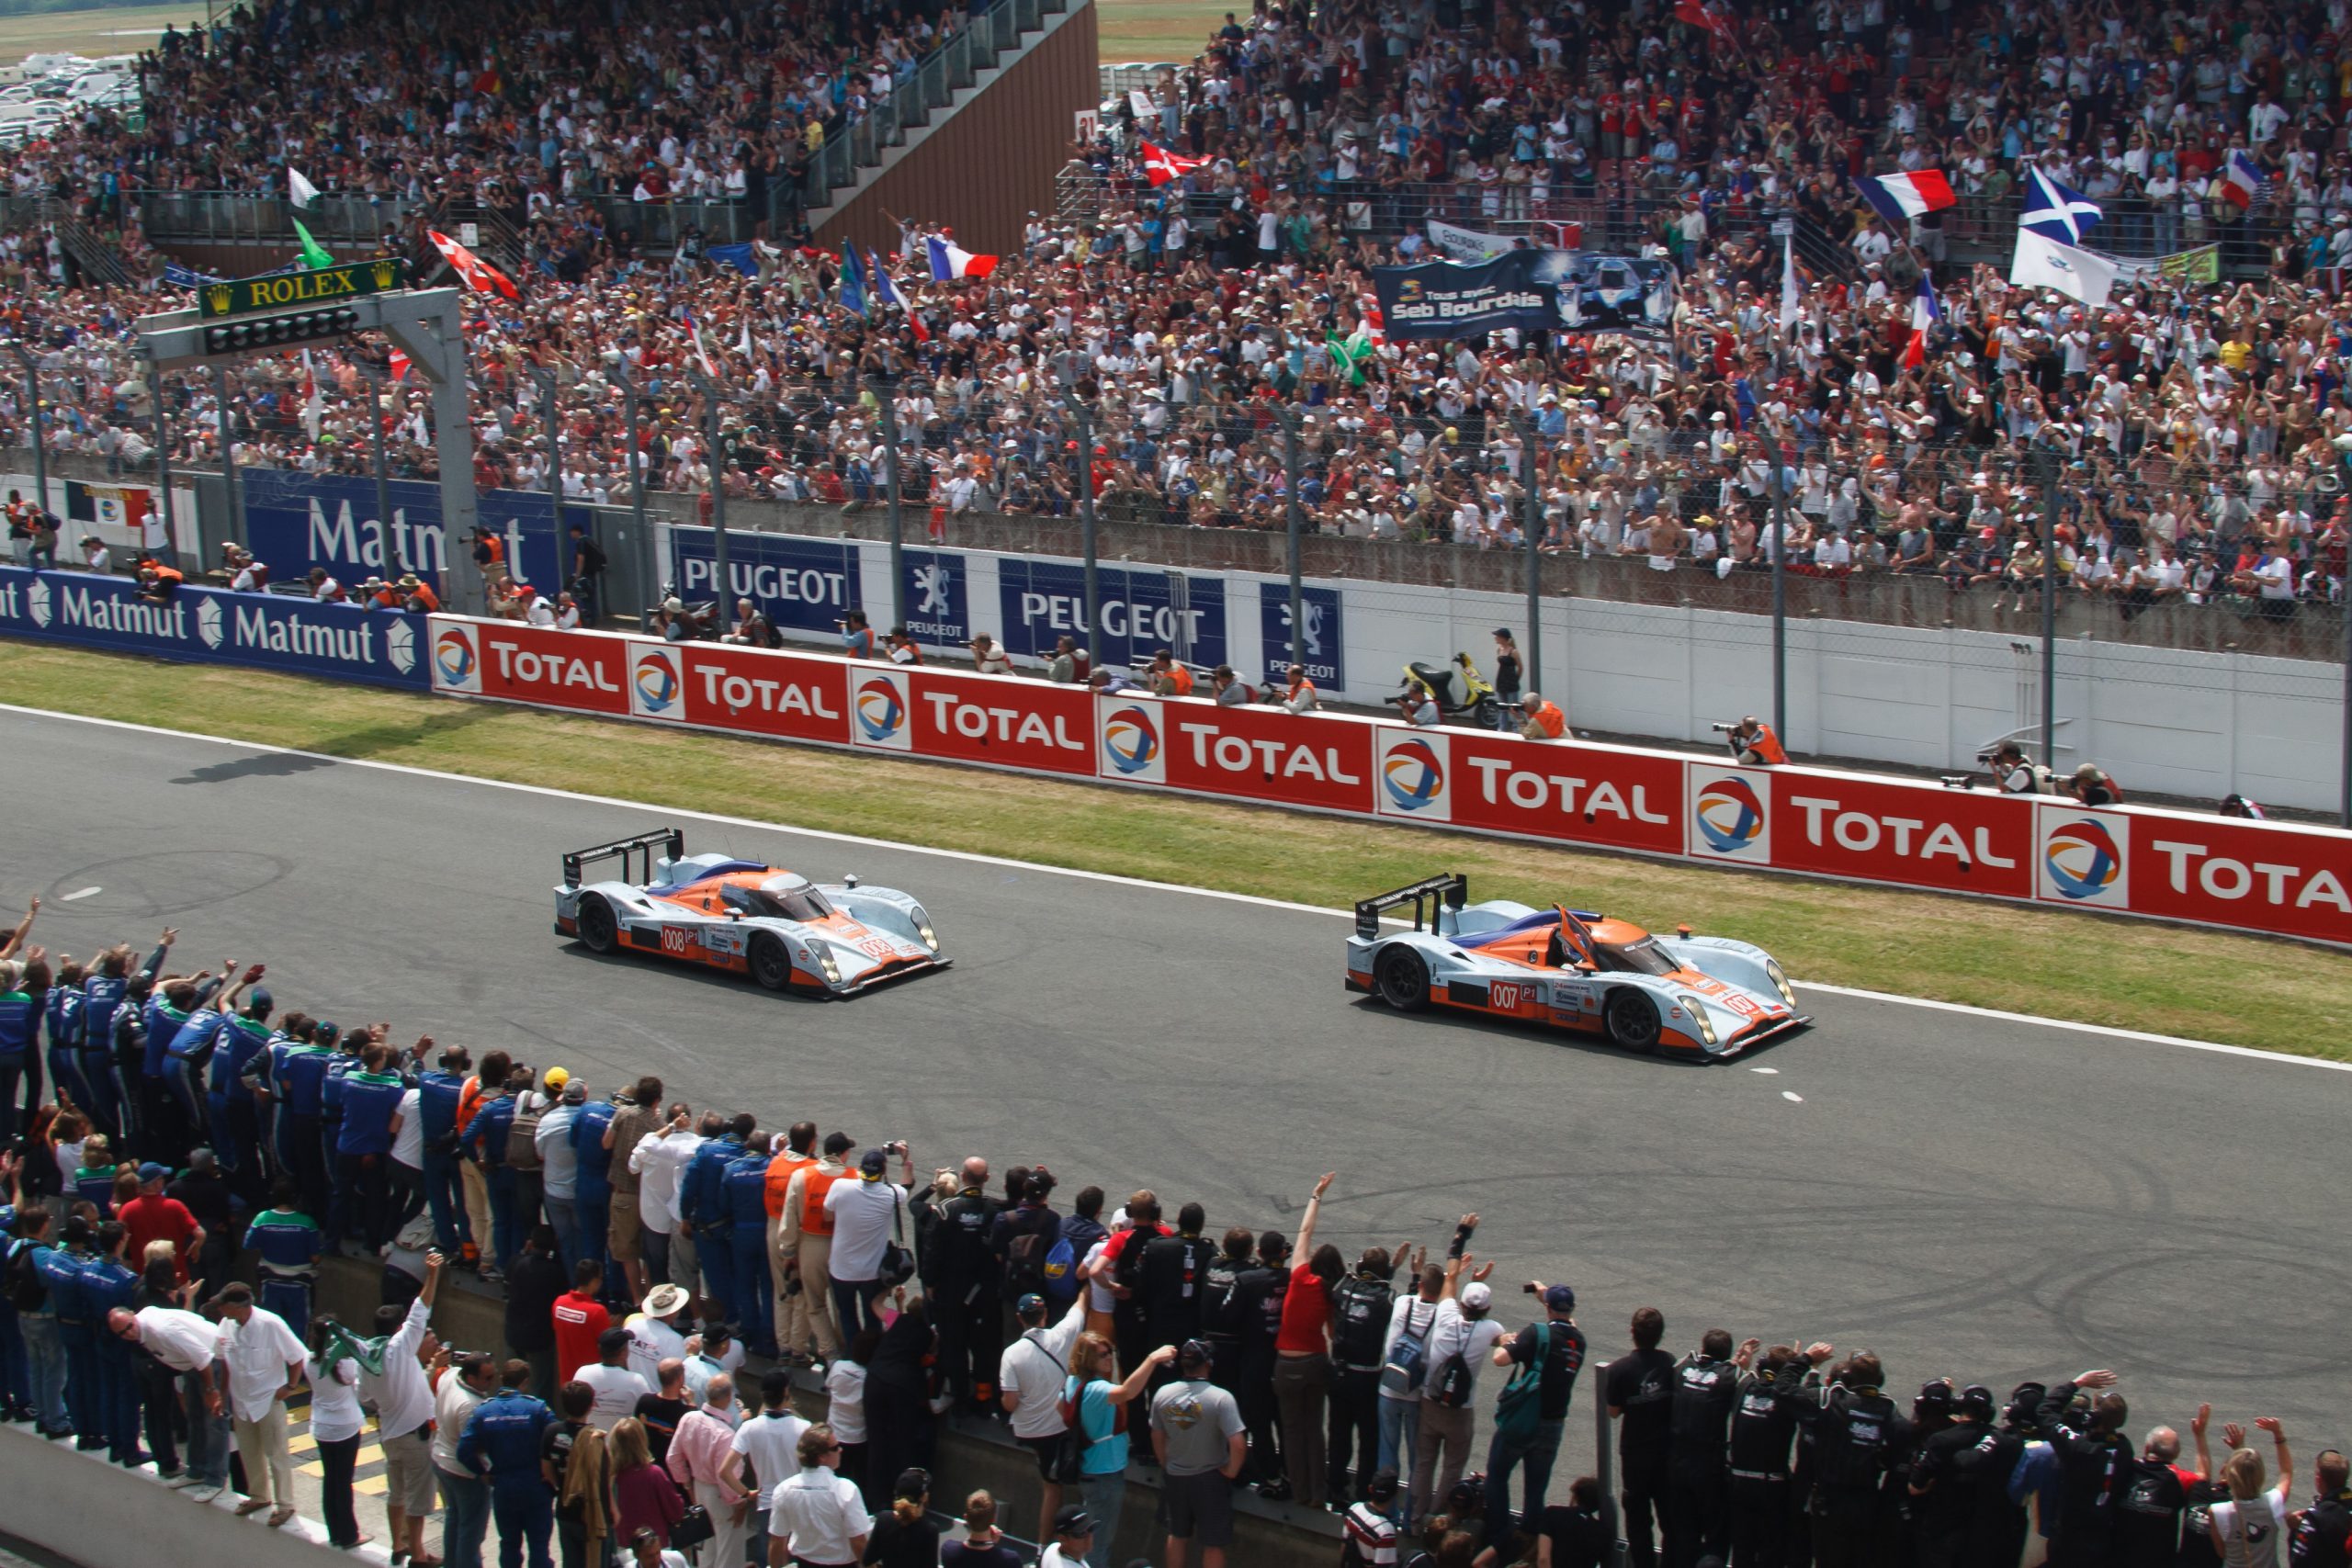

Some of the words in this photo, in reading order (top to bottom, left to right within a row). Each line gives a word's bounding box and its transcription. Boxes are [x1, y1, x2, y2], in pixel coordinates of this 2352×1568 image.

[250, 270, 357, 306] ROLEX
[1392, 303, 1434, 319] Seb
[1439, 292, 1544, 317] Bourdais
[1426, 291, 1458, 300] Tous
[309, 495, 529, 583] Matmt
[684, 558, 844, 605] PEUGEOT
[62, 585, 188, 639] Matmut
[235, 604, 376, 664] Matmut
[906, 621, 963, 637] PEUGEOT
[1022, 592, 1205, 644] PEUGEOT
[490, 641, 619, 693] TOTAL
[1270, 660, 1335, 678] PEEOT
[695, 665, 839, 719] TOTAL
[923, 692, 1084, 750] TOTAL
[1180, 723, 1360, 785] TOTAL
[1467, 756, 1668, 824] TOTAL
[1791, 796, 2016, 868] TOTAL
[664, 929, 684, 953] 008
[687, 931, 698, 942] P1
[1493, 984, 1517, 1009] 007
[1523, 987, 1535, 998] P1
